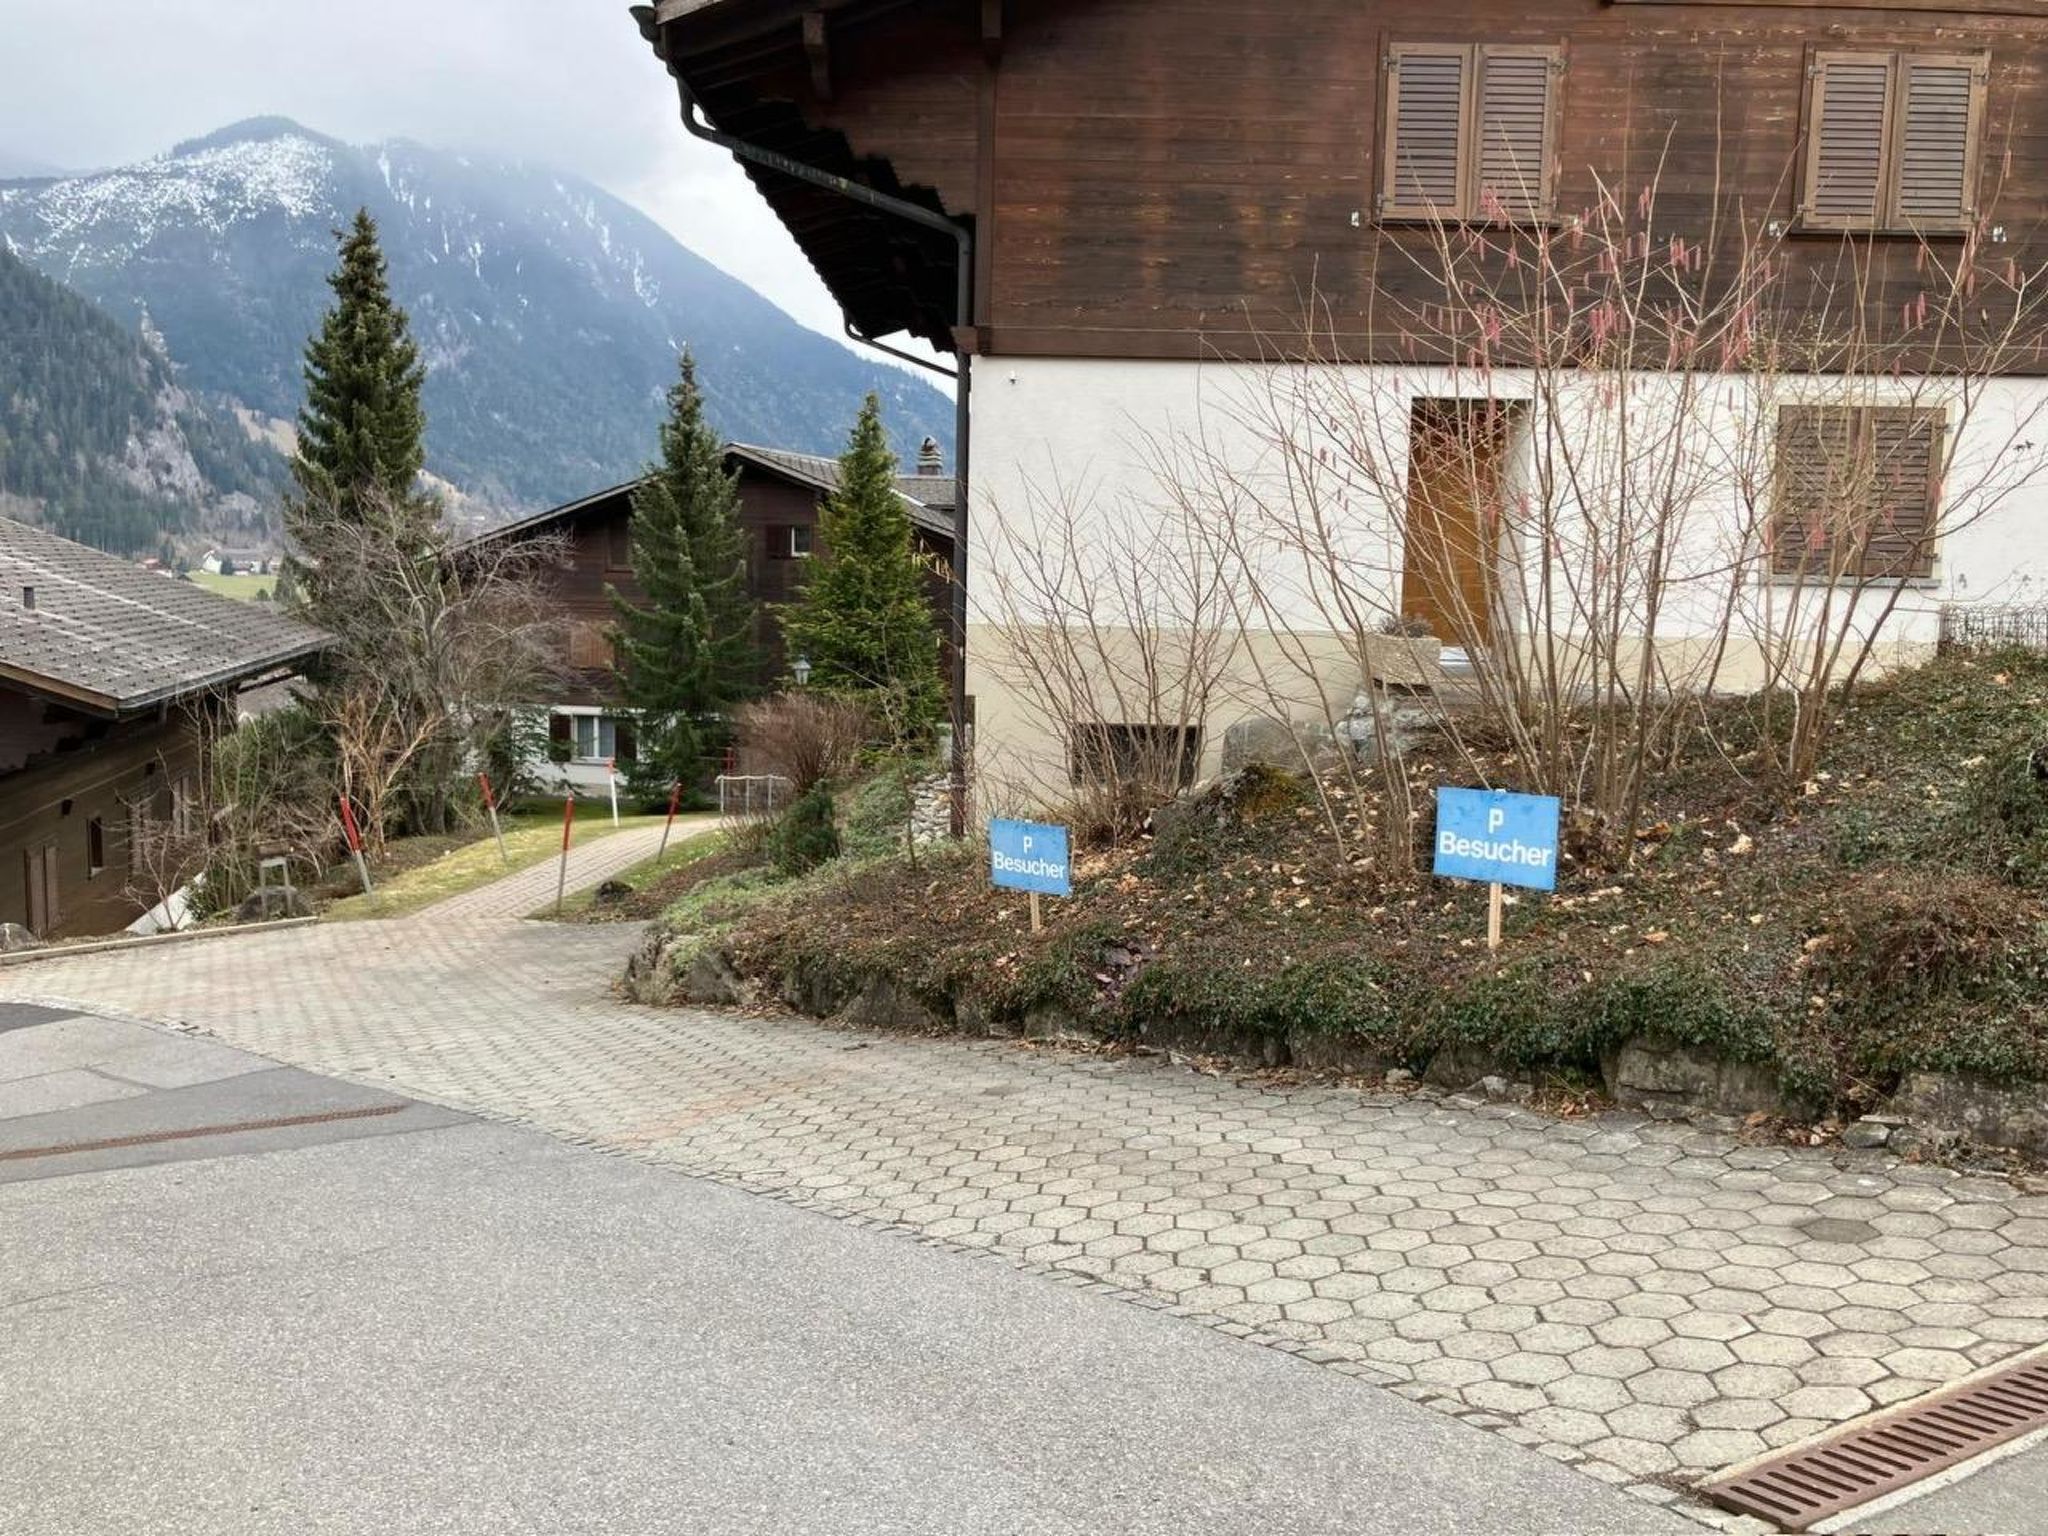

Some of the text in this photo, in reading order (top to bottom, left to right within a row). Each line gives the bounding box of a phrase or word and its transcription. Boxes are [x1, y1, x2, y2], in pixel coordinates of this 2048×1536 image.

[1489, 808, 1505, 833] P
[1023, 836, 1033, 854] P
[1439, 831, 1553, 866] Besucher
[993, 852, 1065, 879] Besucher
